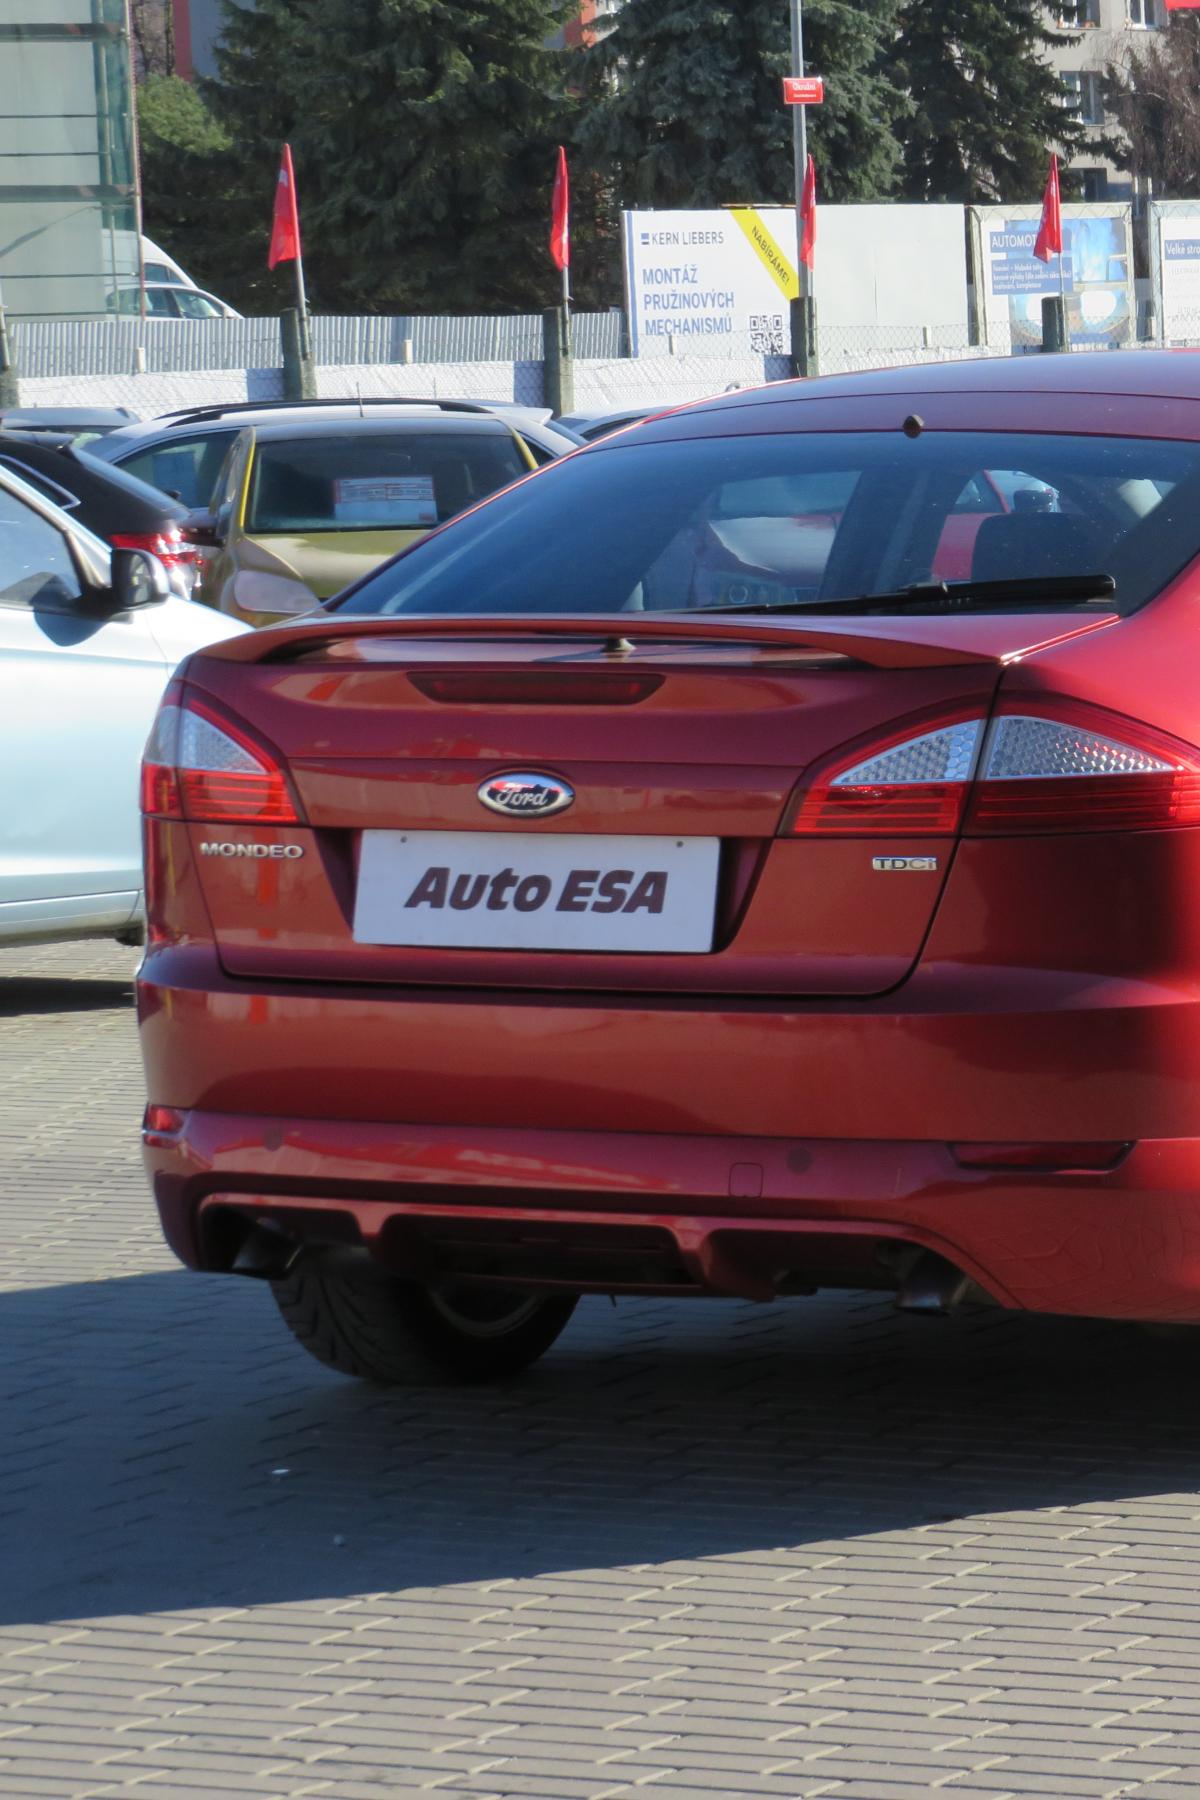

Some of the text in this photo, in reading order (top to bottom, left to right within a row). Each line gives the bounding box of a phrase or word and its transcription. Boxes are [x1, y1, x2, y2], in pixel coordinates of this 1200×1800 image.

[652, 231, 725, 246] KERN LIEBERS
[991, 233, 1037, 248] AUTOMOT
[751, 225, 791, 287] NABÍRÁME!
[1165, 241, 1185, 256] Velké
[642, 263, 698, 285] MONTÁŽ
[644, 288, 735, 311] PRUŽINOVÝCH
[645, 311, 733, 337] MECHANISMŮ
[496, 787, 549, 806] Ford
[200, 842, 304, 859] MONDEO
[874, 857, 936, 870] TDCi
[403, 865, 669, 915] Auto ESA
